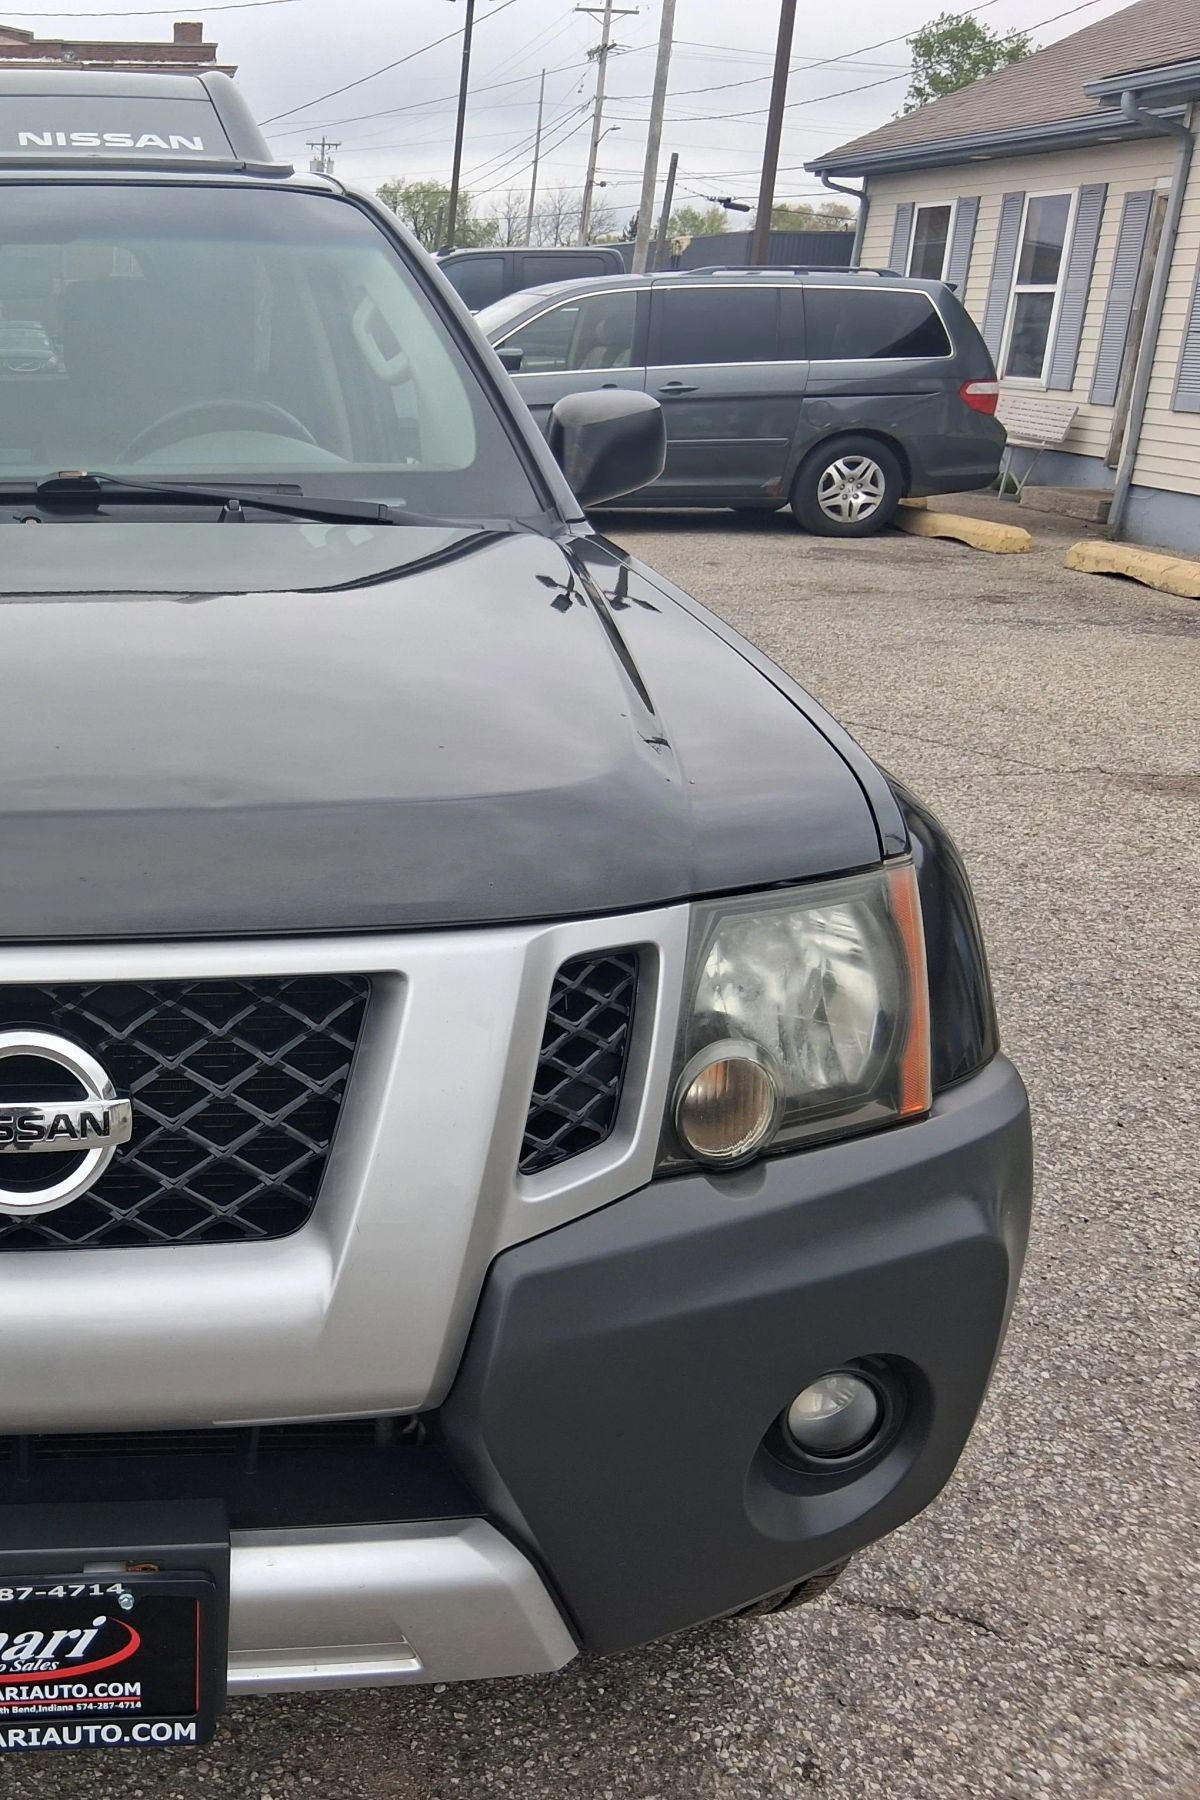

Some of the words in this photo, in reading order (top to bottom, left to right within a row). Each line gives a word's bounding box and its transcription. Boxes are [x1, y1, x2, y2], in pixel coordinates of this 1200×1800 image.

[17, 130, 204, 152] NISSAN
[9, 1657, 60, 1674] Sales
[75, 1700, 143, 1712] 574-287-4714
